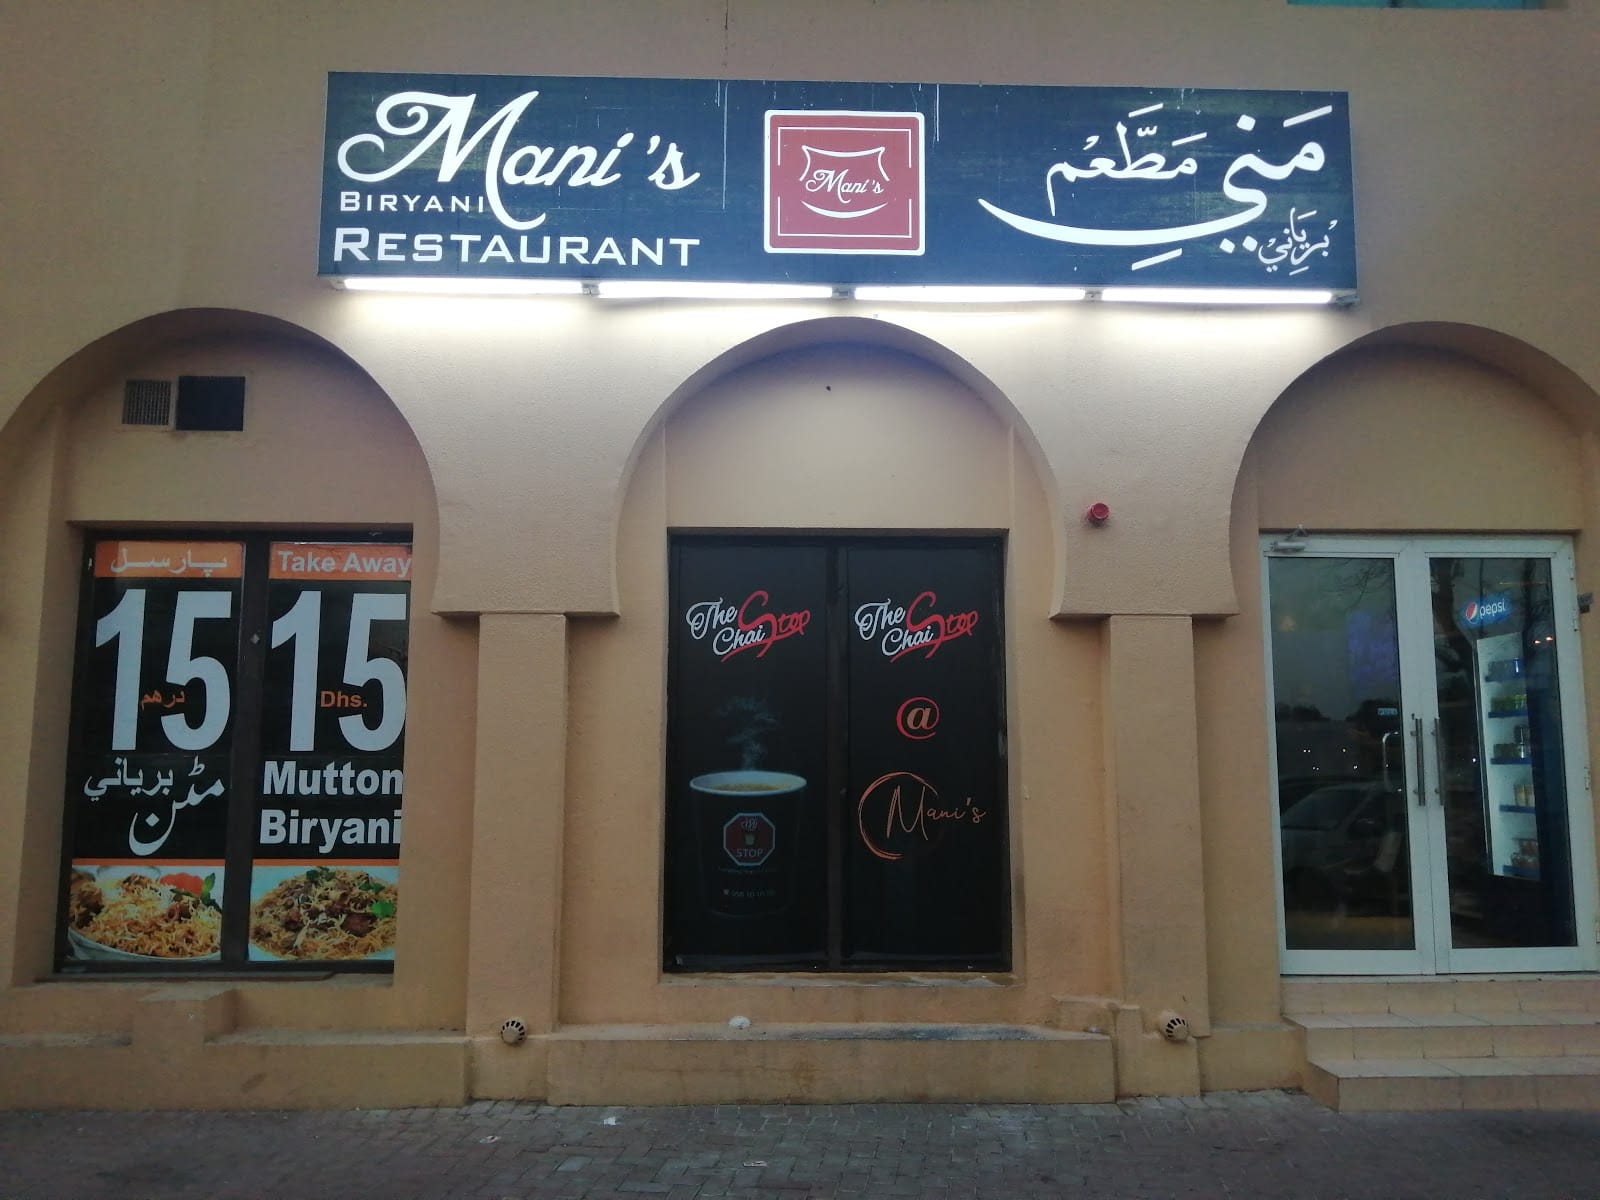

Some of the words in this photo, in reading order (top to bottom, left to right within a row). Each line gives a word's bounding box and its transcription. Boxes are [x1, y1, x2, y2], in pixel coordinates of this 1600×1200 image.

[337, 90, 700, 231] Mani's
[339, 191, 484, 213] BIRYANI
[805, 169, 884, 204] Mani's
[333, 227, 700, 266] RESTAURANT
[277, 551, 336, 573] Take
[342, 552, 411, 577] Away
[685, 597, 738, 640] The
[712, 624, 766, 656] Chai
[854, 598, 906, 641] The
[881, 625, 934, 656] Chai
[1479, 598, 1507, 620] pepsi
[95, 588, 233, 751] 15
[271, 590, 407, 752] 15
[141, 690, 186, 711] درهم
[320, 690, 368, 709] Dhs.
[262, 760, 404, 796] Mutton
[259, 809, 401, 854] Biryani
[886, 785, 987, 841] Mani's
[736, 848, 764, 858] STOP
